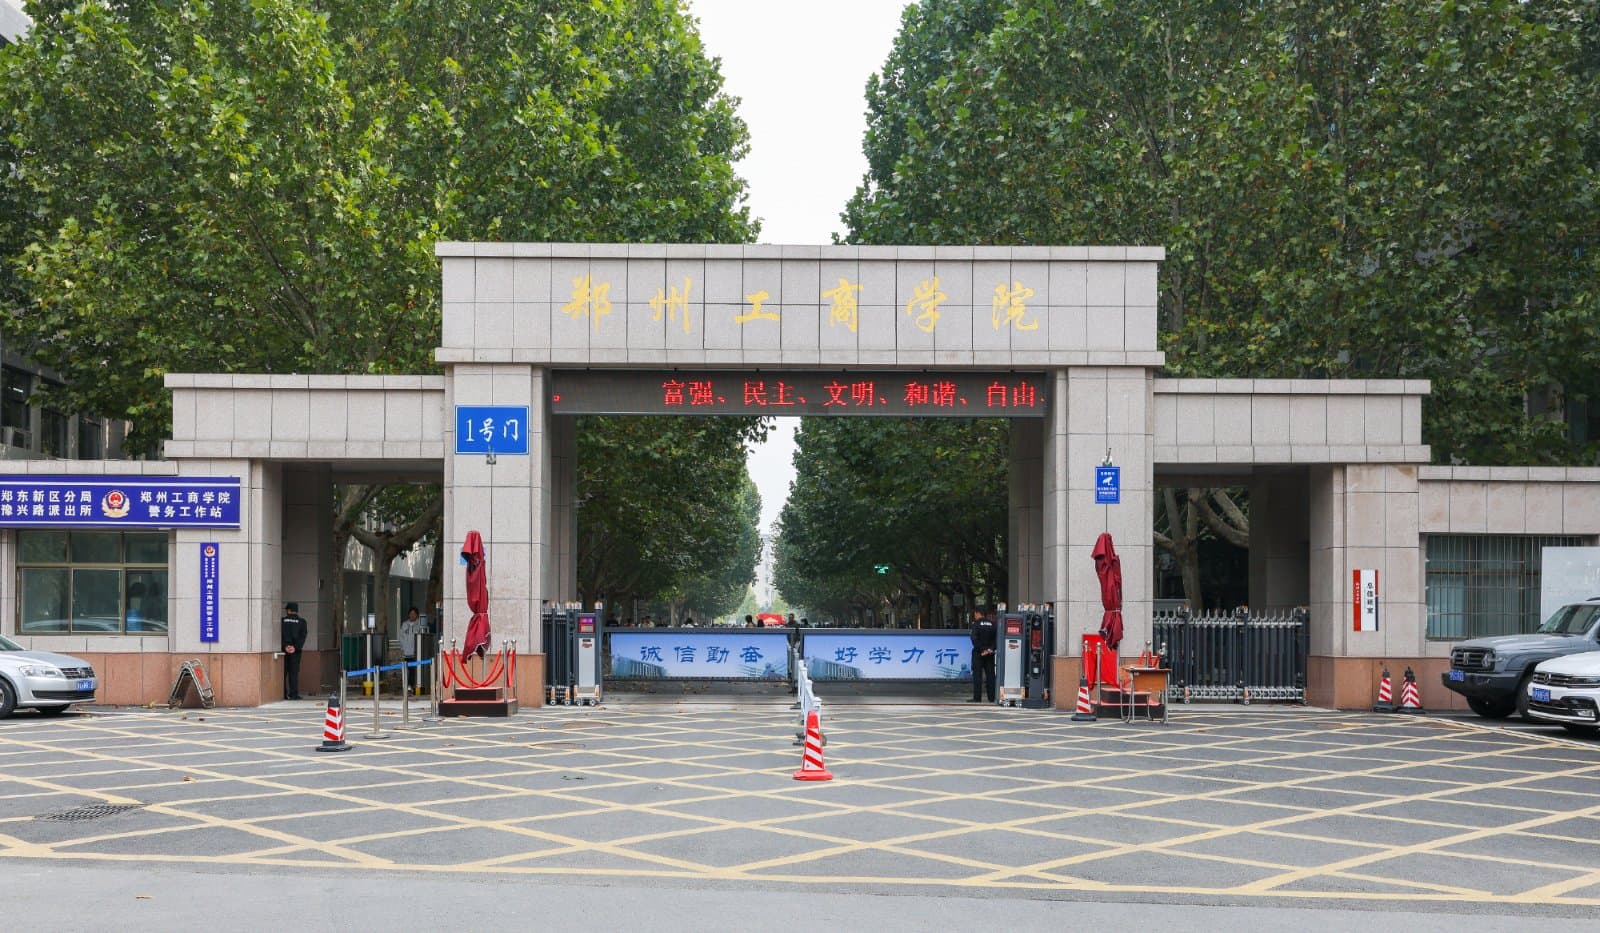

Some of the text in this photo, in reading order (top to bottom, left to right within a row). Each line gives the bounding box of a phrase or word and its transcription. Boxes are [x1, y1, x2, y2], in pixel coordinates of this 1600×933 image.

[562, 274, 1039, 336] 郑州工商学院
[465, 417, 519, 442] 1号门
[1, 489, 92, 503] 郑东新区分局
[140, 491, 231, 504] 郑州工商学院
[1, 503, 92, 517] 豫兴路派出所
[148, 505, 222, 518] 警务工作站
[640, 645, 763, 664] 诚信勤奋
[834, 646, 959, 665] 好学力行
